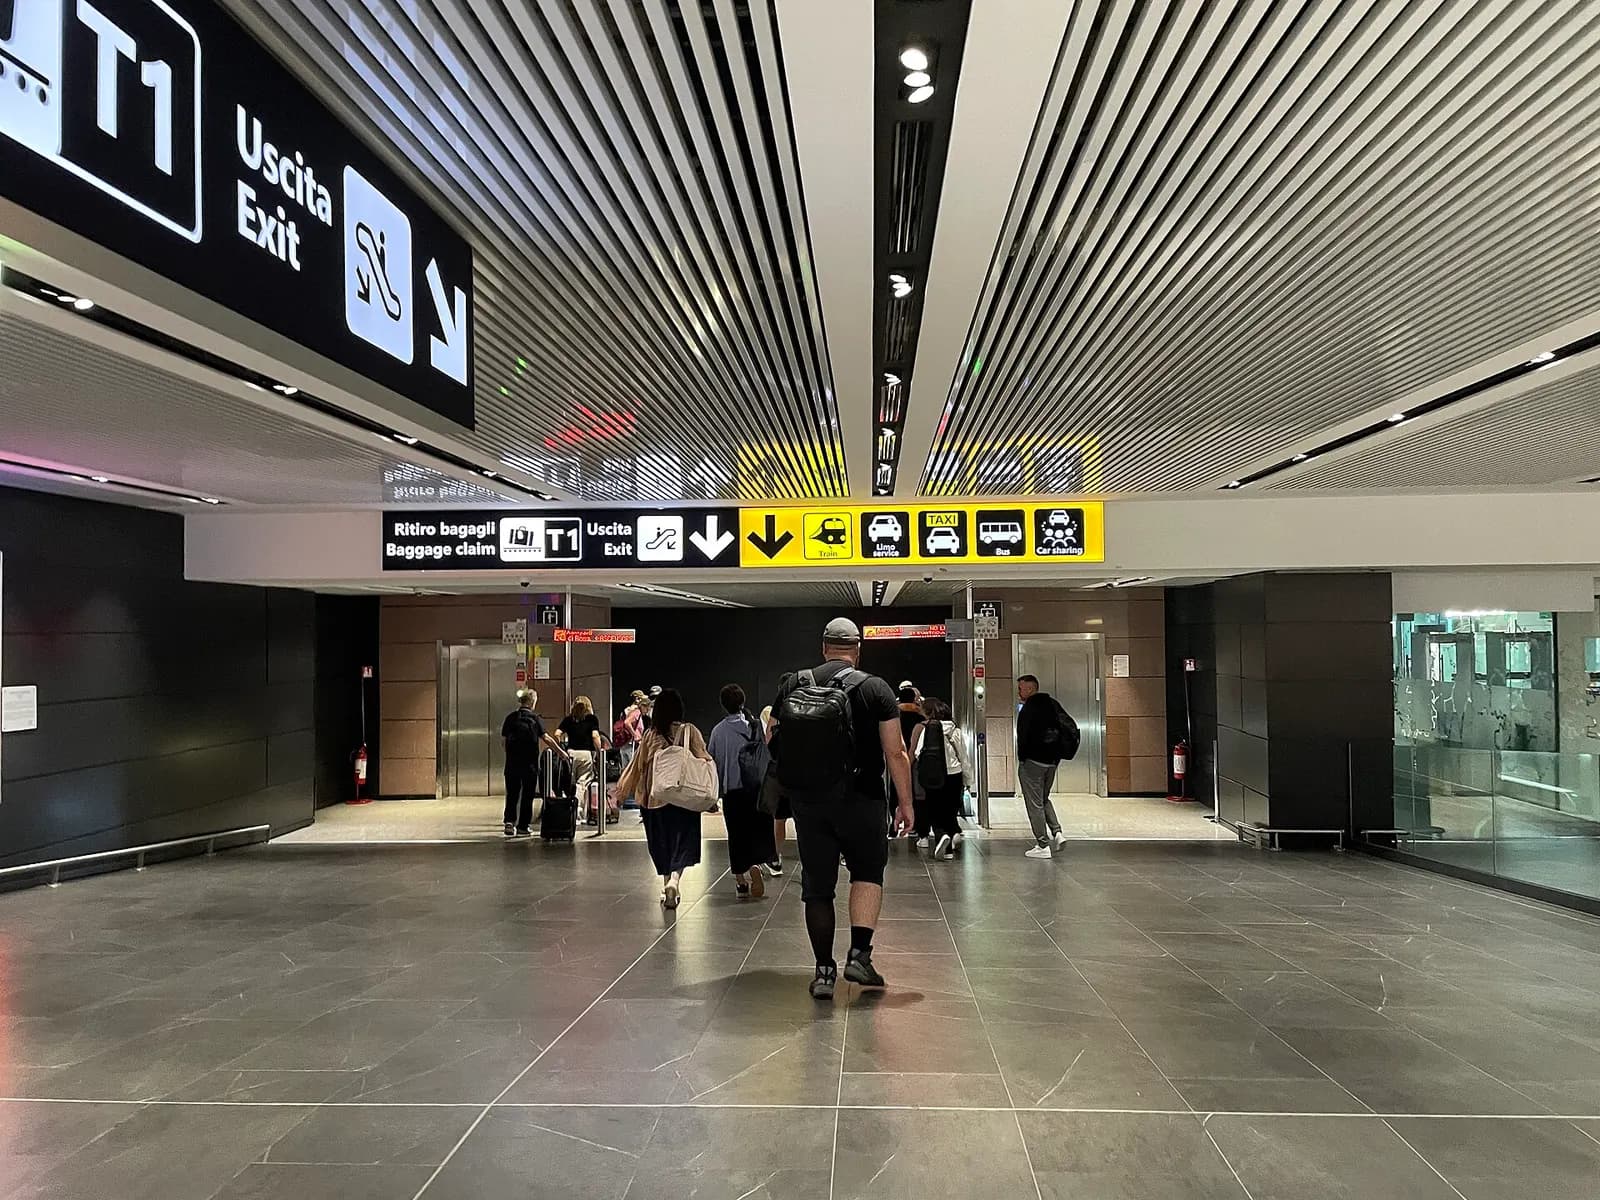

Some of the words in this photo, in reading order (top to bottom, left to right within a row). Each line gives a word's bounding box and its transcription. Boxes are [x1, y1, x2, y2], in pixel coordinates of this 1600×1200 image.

[77, 0, 172, 176] T1
[237, 104, 332, 227] Uscita
[237, 179, 301, 271] Exit
[928, 514, 957, 525] TAXI
[394, 522, 436, 536] Ritiro
[440, 521, 496, 538] bagagli
[587, 521, 632, 536] Uscita
[545, 528, 578, 551] T1
[876, 543, 896, 551] Limo
[386, 543, 452, 559] Baggage
[455, 542, 496, 556] claim
[604, 542, 632, 556] Exit
[818, 550, 838, 558] Train
[1036, 547, 1052, 555] Car
[1052, 546, 1083, 556] sharing
